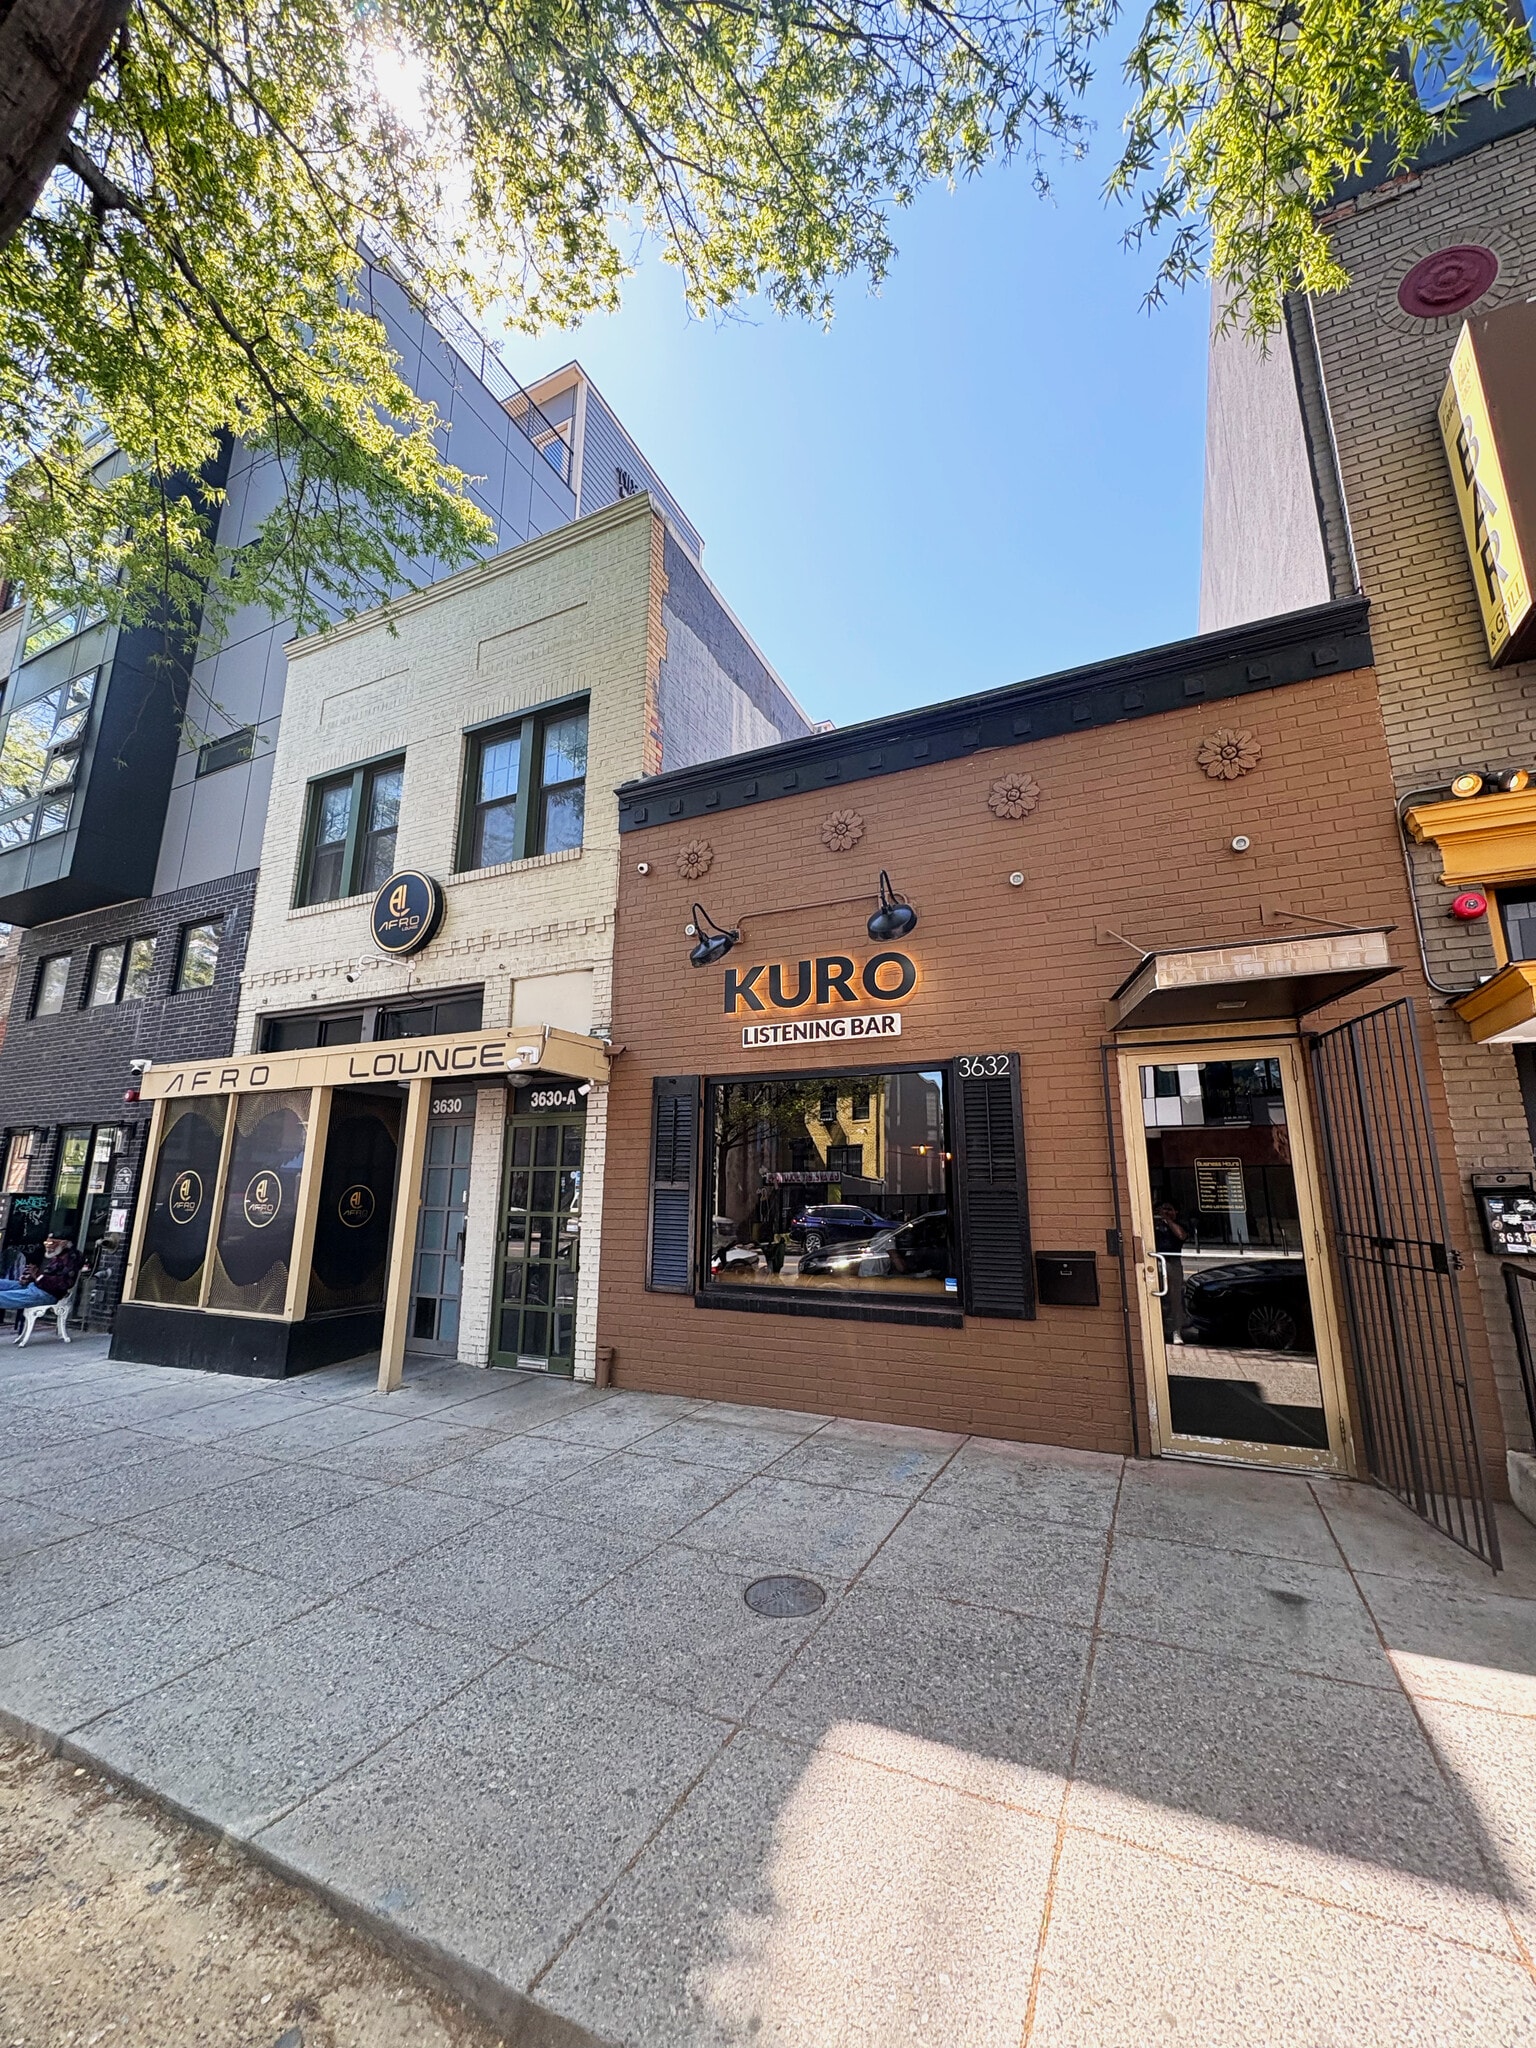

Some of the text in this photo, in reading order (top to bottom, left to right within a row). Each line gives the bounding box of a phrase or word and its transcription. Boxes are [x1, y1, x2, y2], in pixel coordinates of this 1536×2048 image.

[378, 915, 420, 932] AFRO
[723, 951, 917, 1014] KURO
[743, 1015, 896, 1045] LISTENING BAR
[165, 1042, 506, 1093] AFRO LOUNGE
[958, 1055, 1010, 1077] 3632
[432, 1098, 462, 1115] 3630
